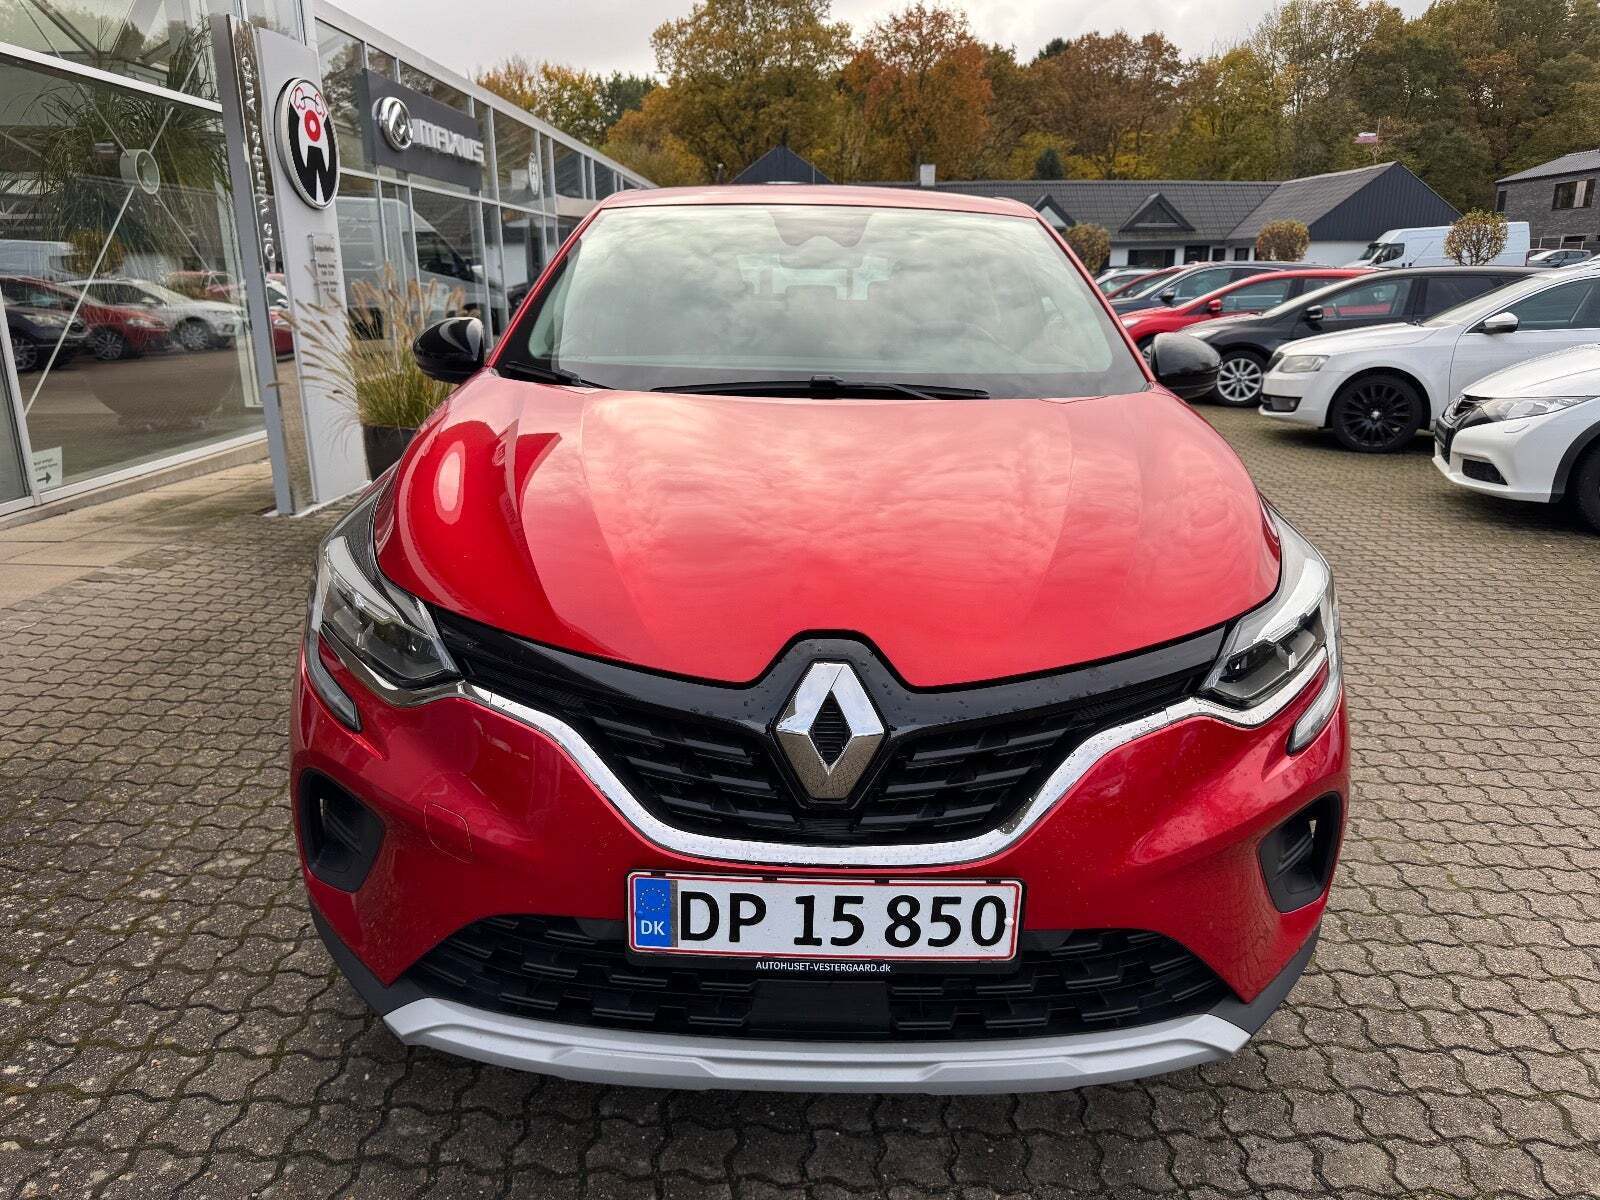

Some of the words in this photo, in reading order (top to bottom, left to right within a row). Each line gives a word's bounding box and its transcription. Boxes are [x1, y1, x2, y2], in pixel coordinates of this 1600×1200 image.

[412, 118, 485, 163] MAXUS
[640, 920, 665, 936] DK
[680, 891, 767, 942] DP
[793, 895, 865, 946] 15
[884, 895, 1007, 947] 850
[755, 960, 892, 973] AUTOHUSET-VESTERGAARD.dk
